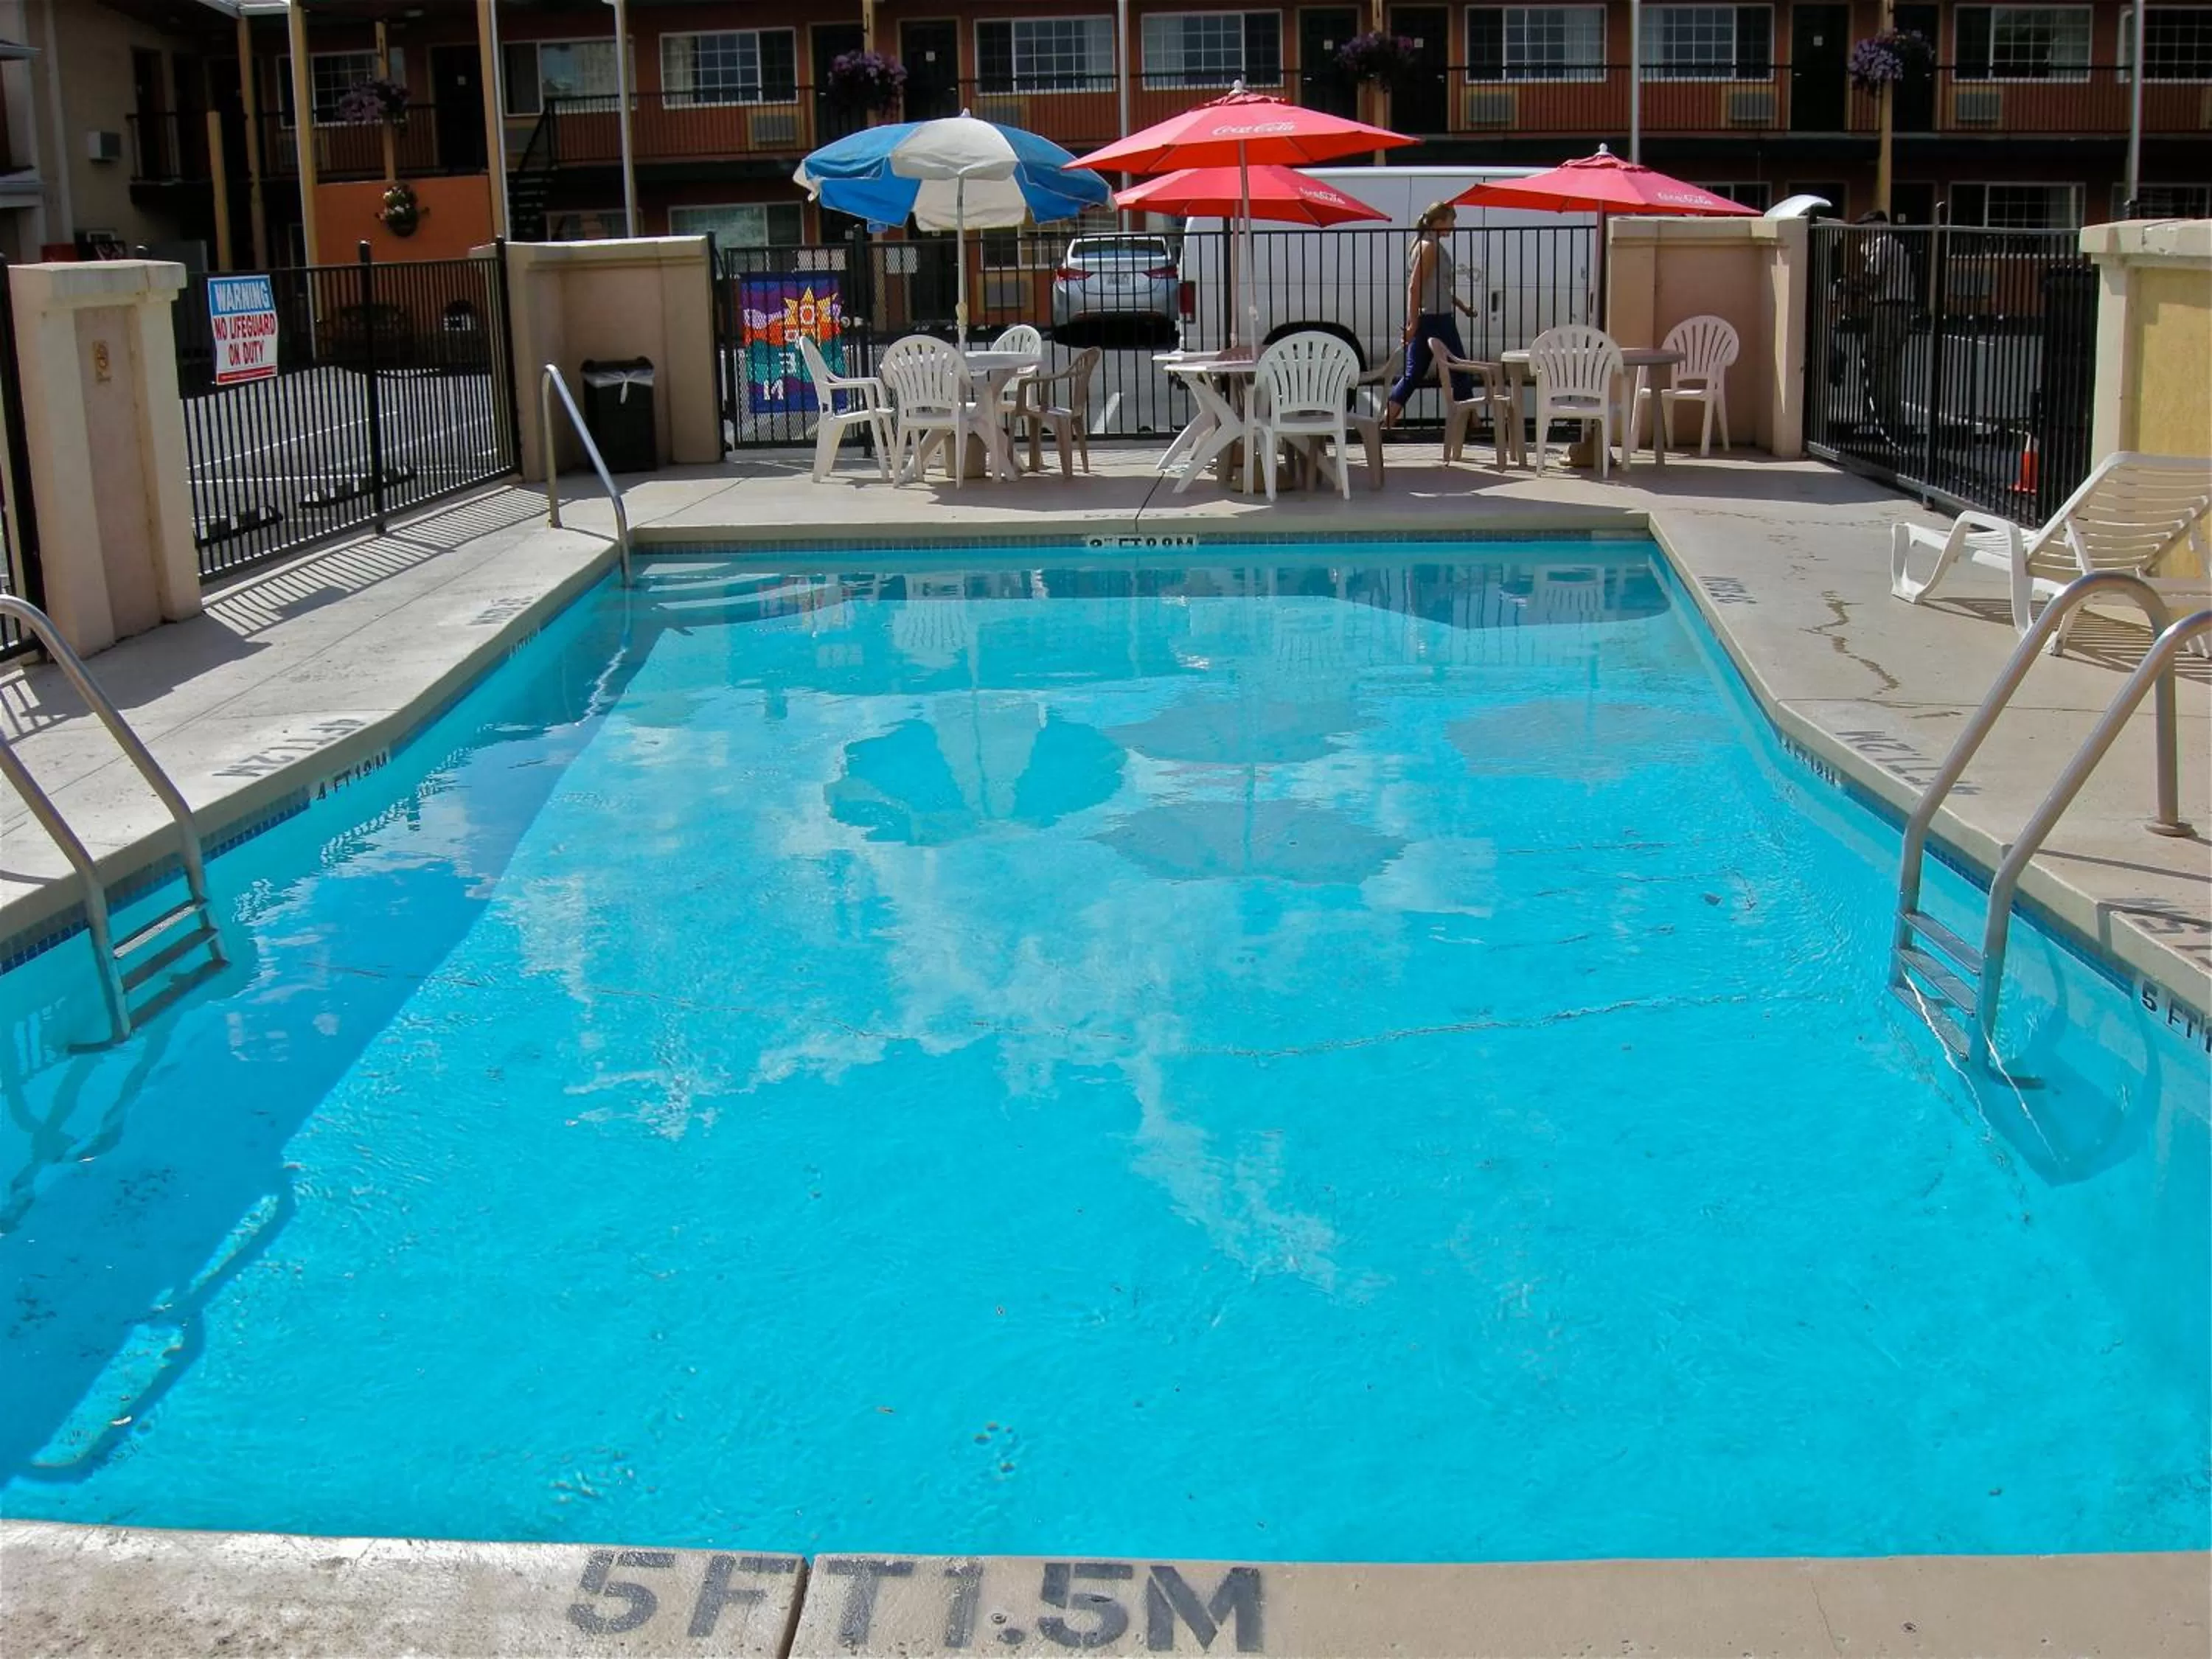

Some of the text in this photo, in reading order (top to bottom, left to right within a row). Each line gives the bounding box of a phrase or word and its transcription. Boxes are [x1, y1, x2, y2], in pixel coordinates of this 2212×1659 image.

[215, 279, 271, 312] WARNING
[214, 313, 276, 341] NO LIFEGUARD
[229, 340, 264, 366] ON DUTY
